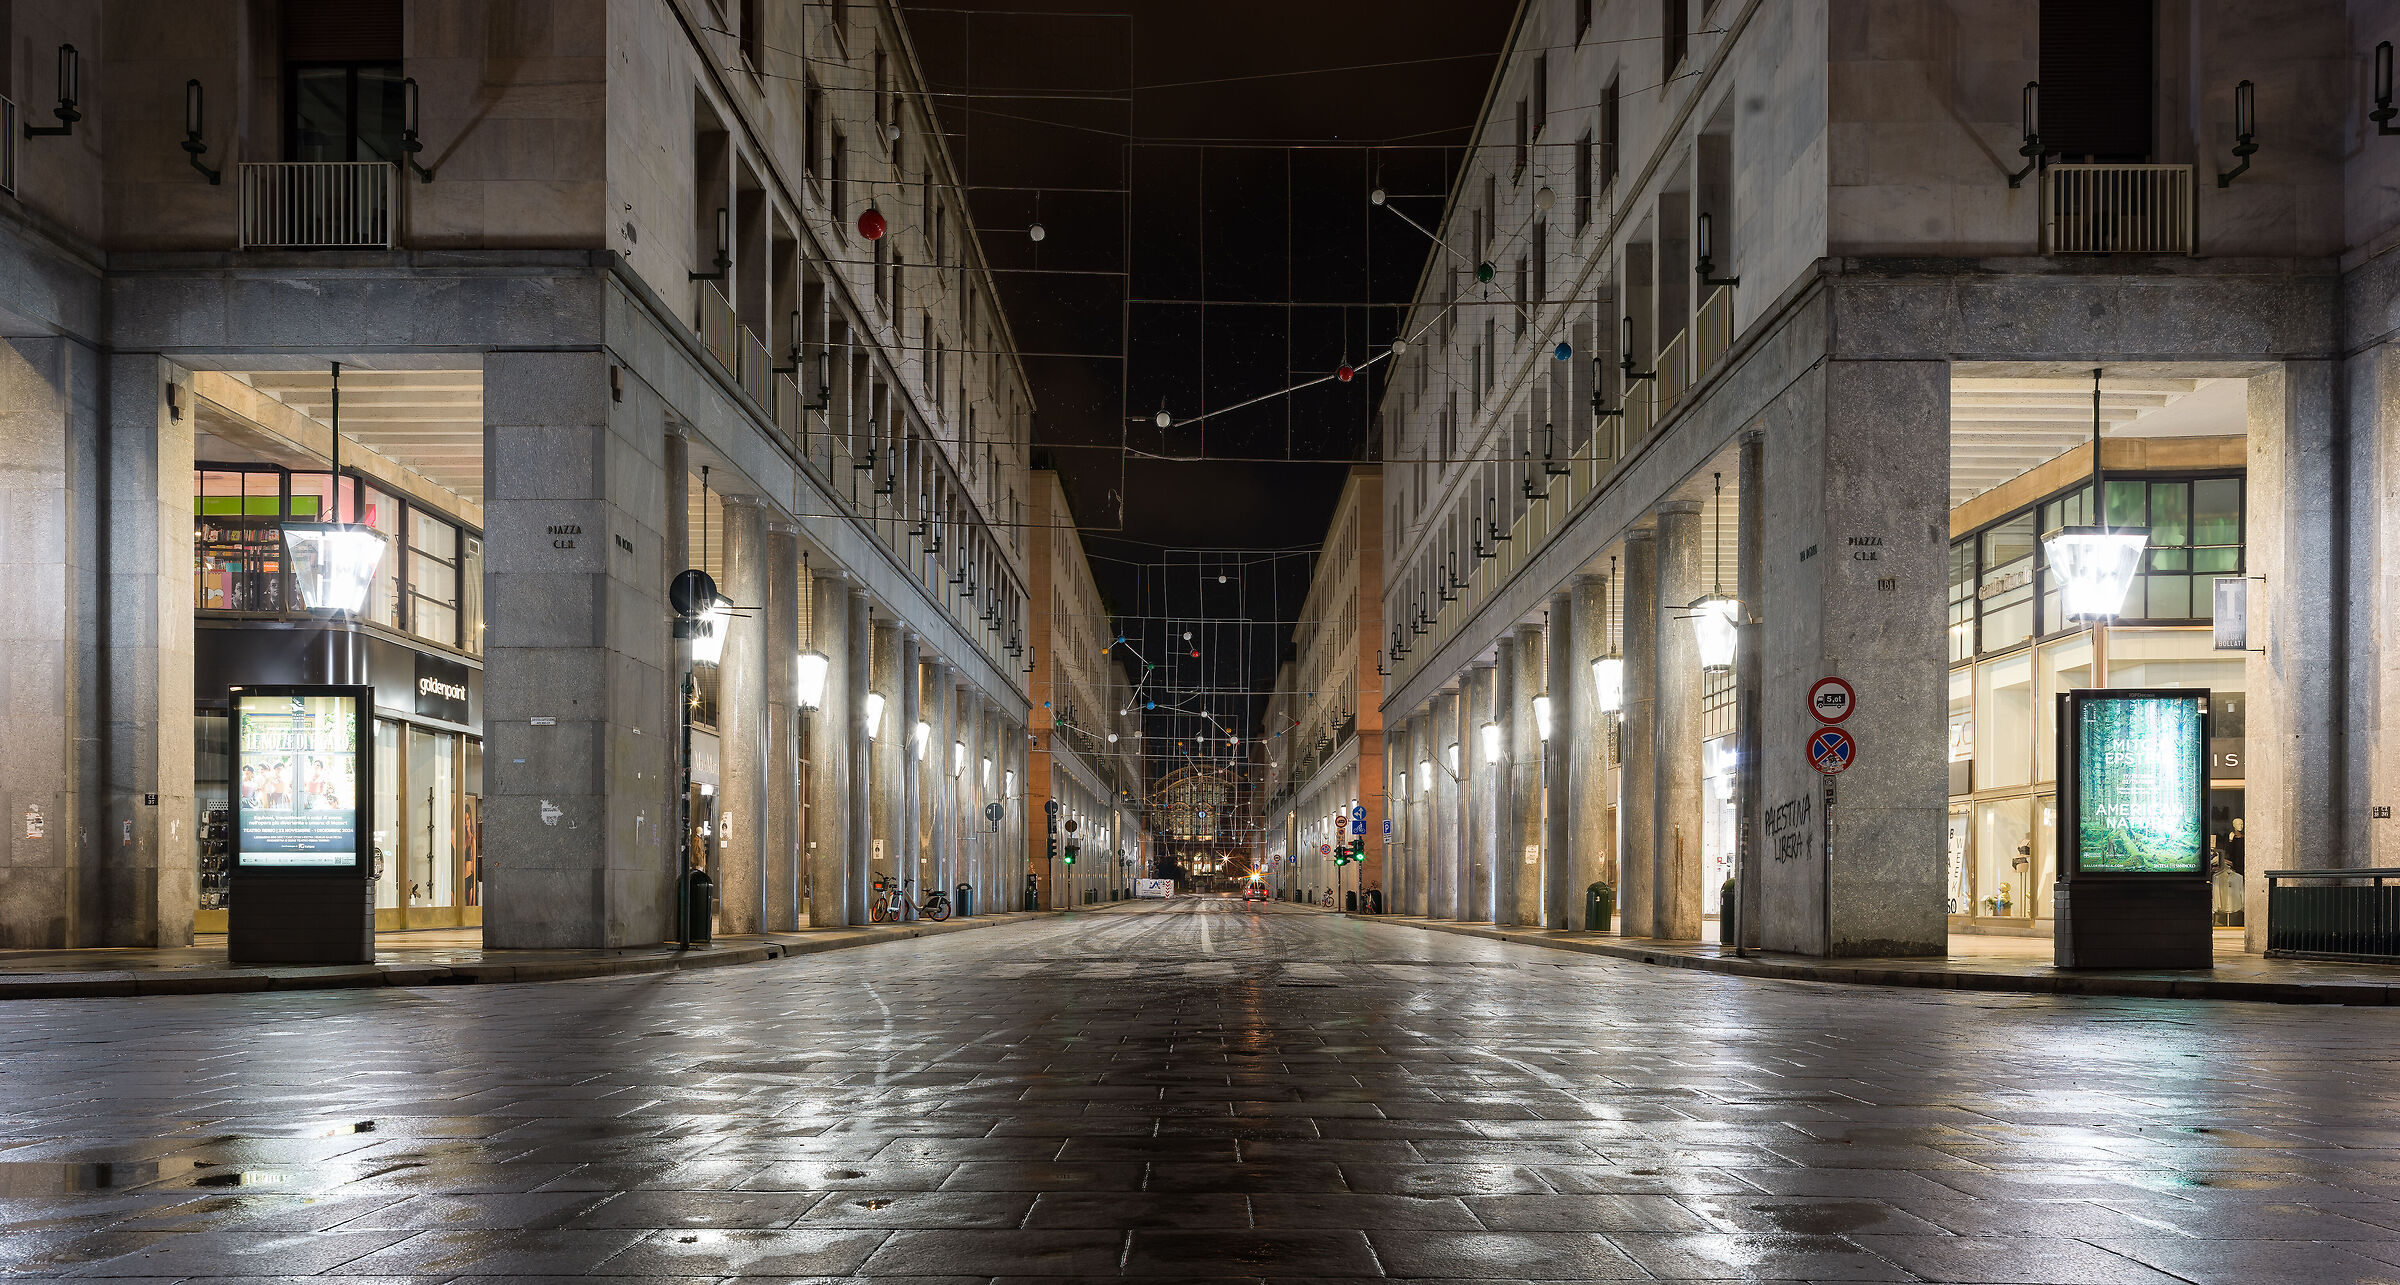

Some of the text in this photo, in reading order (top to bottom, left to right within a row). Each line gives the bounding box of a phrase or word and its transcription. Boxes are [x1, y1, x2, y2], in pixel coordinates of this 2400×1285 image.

[548, 526, 582, 534] PIAZZA
[1848, 537, 1883, 546] PIAZZA
[420, 677, 466, 701] goldenpoint
[1765, 793, 1811, 836] PALESTINA
[1774, 831, 1802, 864] LIBERA
